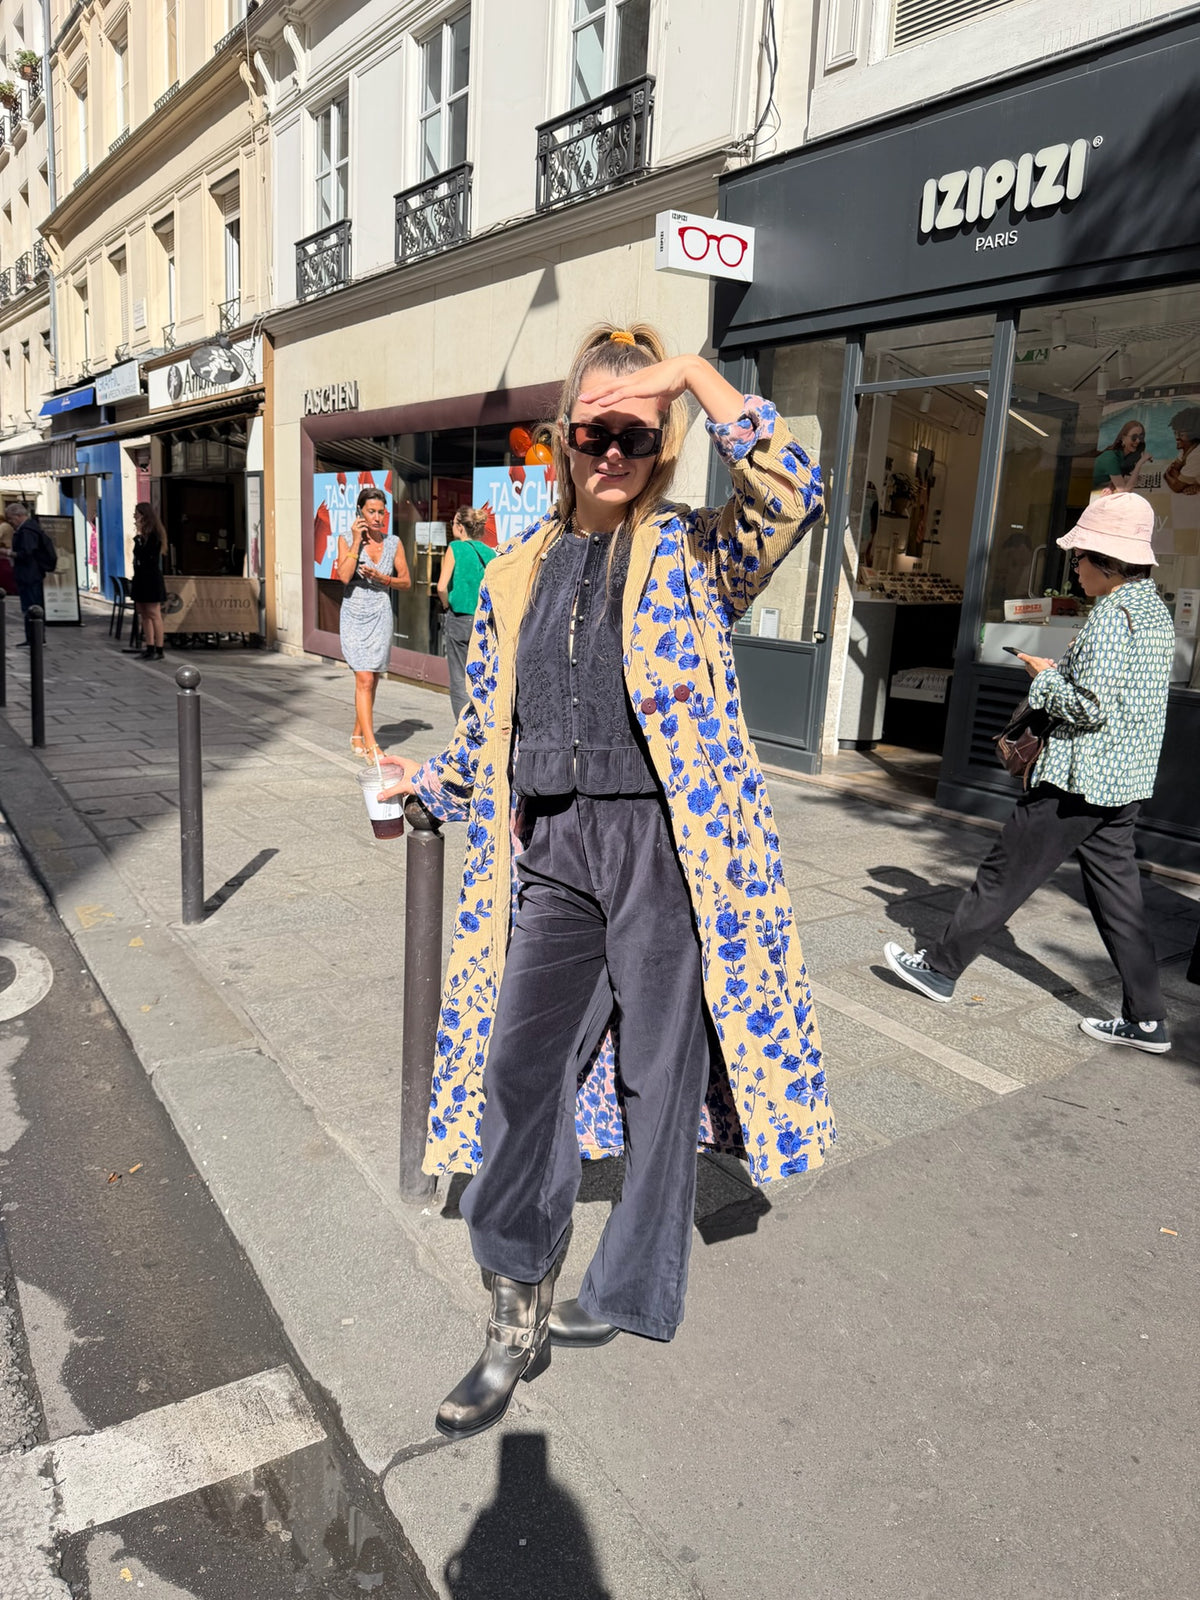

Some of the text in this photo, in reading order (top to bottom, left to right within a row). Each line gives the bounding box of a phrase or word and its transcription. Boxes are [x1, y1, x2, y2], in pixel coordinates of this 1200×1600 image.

[920, 138, 1089, 234] IZIPIZI
[975, 230, 1018, 251] PARIS
[302, 380, 359, 417] TASCHEN
